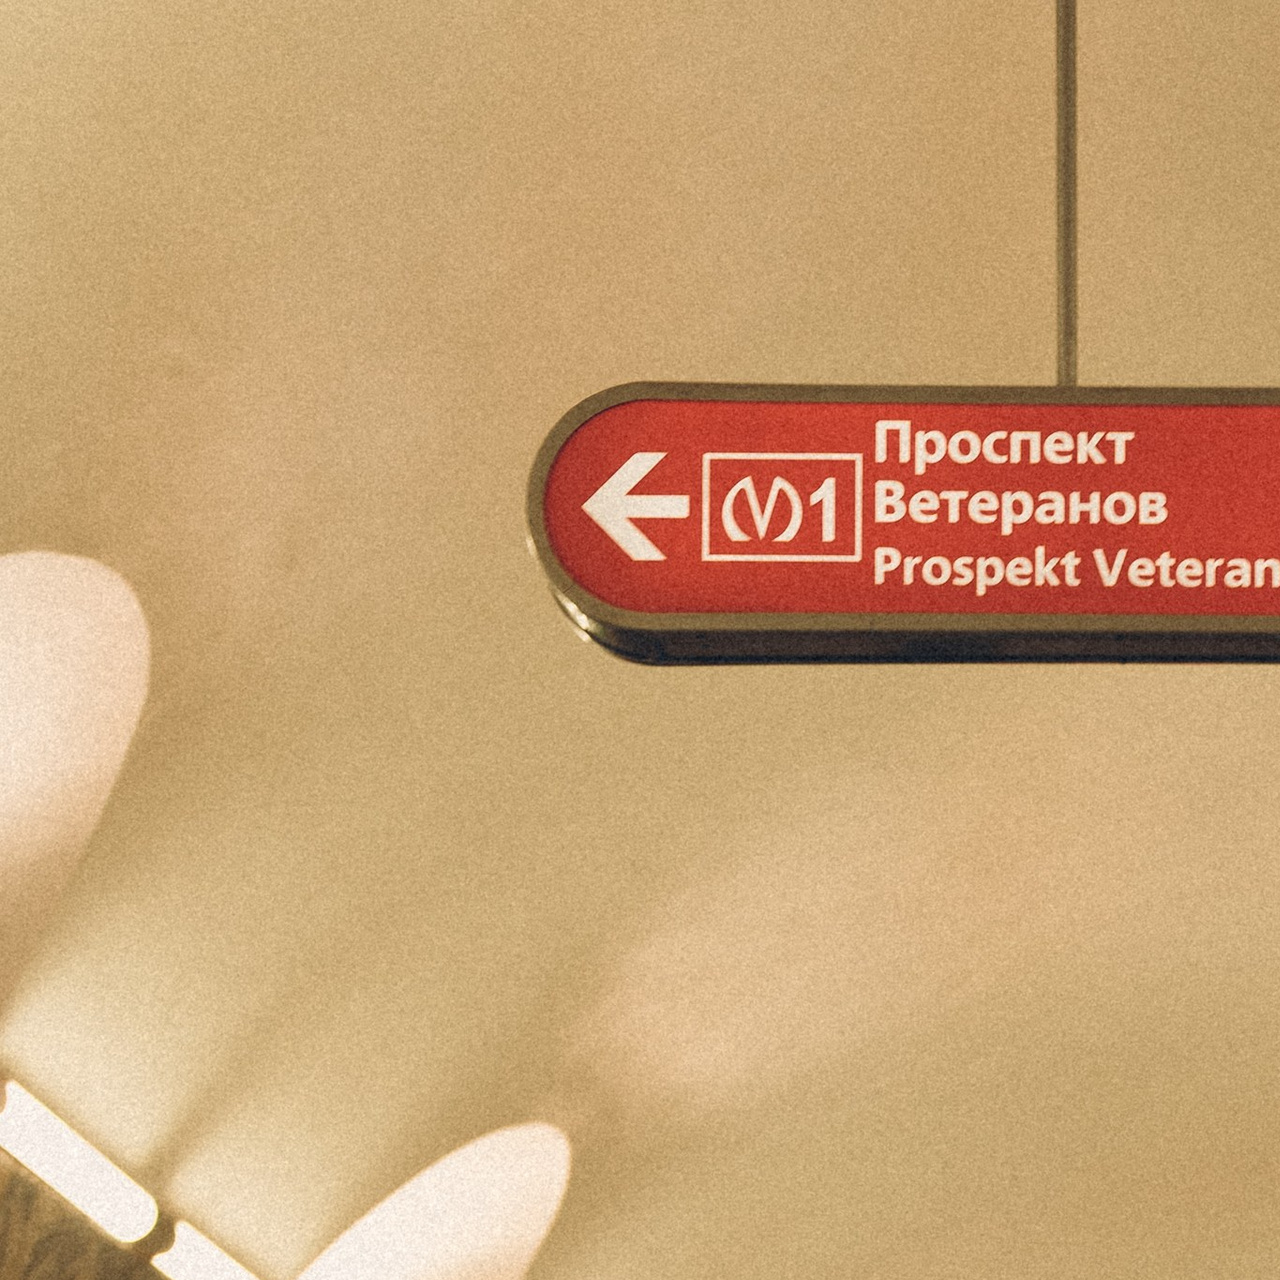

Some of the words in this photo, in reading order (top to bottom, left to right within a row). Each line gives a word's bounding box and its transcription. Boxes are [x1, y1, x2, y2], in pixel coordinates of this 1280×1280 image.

[875, 420, 1134, 475] Проспект
[875, 480, 1167, 535] Ветеранов
[875, 546, 1080, 596] Prospekt
